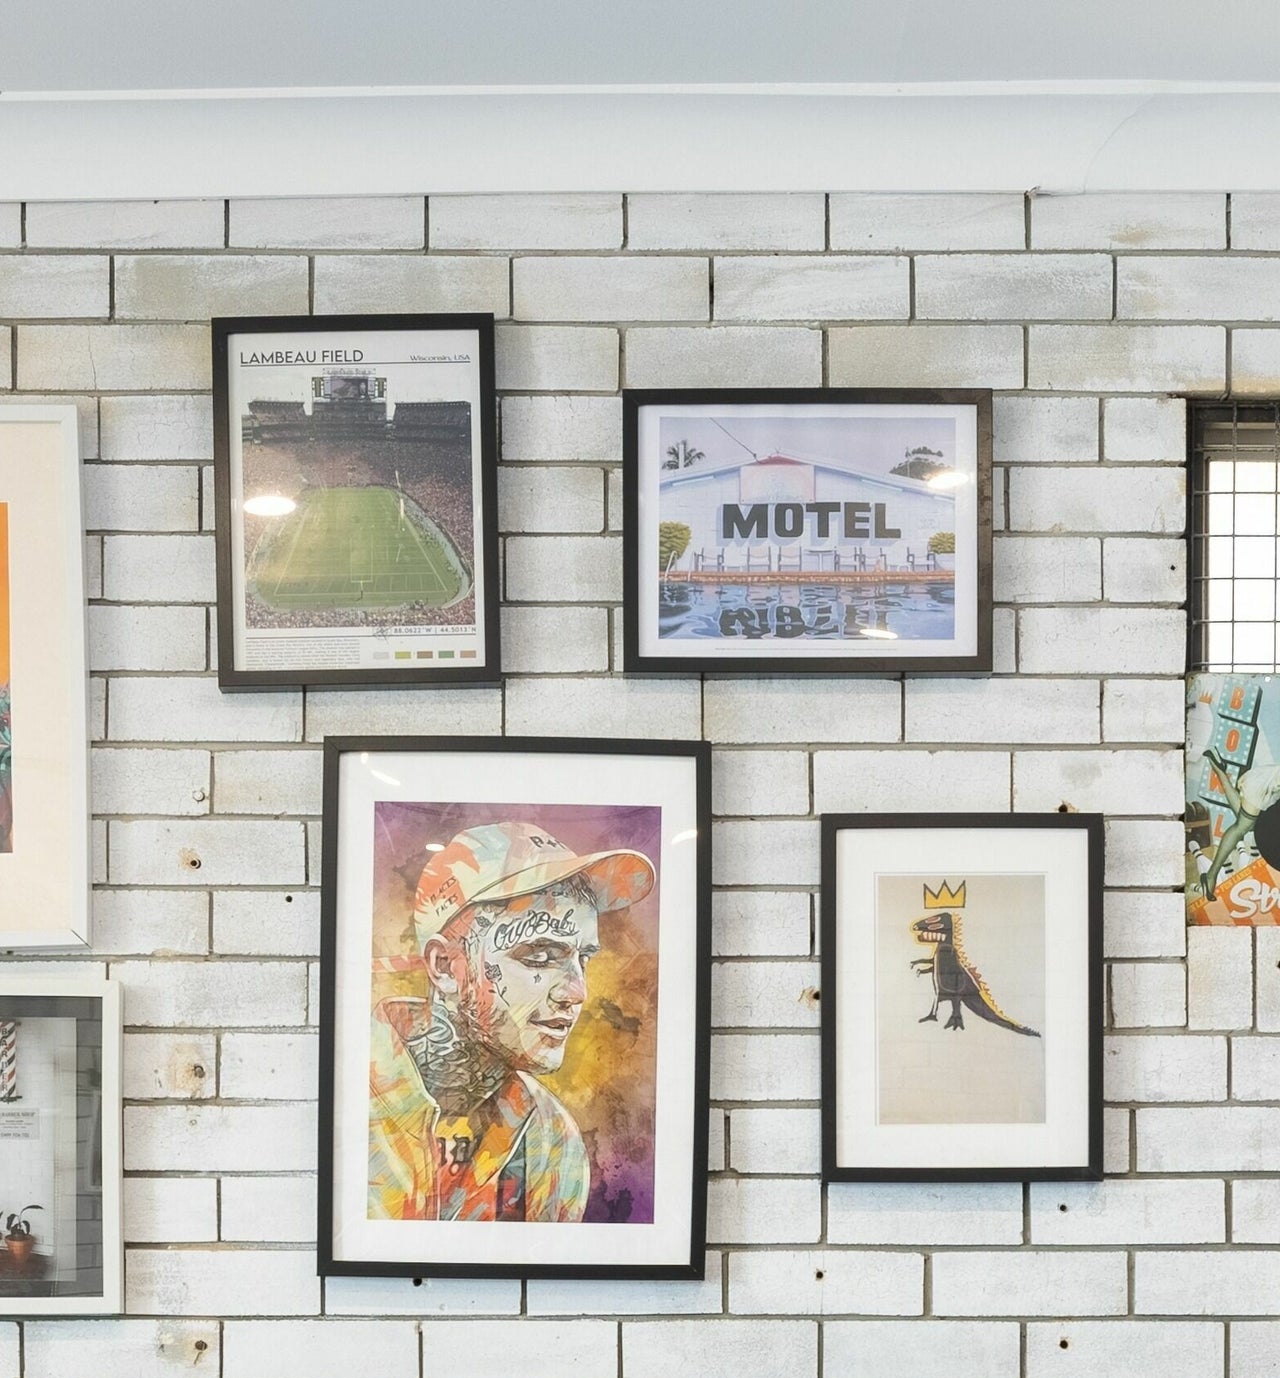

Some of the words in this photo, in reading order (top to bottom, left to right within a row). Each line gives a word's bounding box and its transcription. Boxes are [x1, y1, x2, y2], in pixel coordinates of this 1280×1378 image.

[240, 350, 317, 365] LAMBEAU
[321, 349, 364, 363] FIELD
[722, 501, 902, 540] MOTEL
